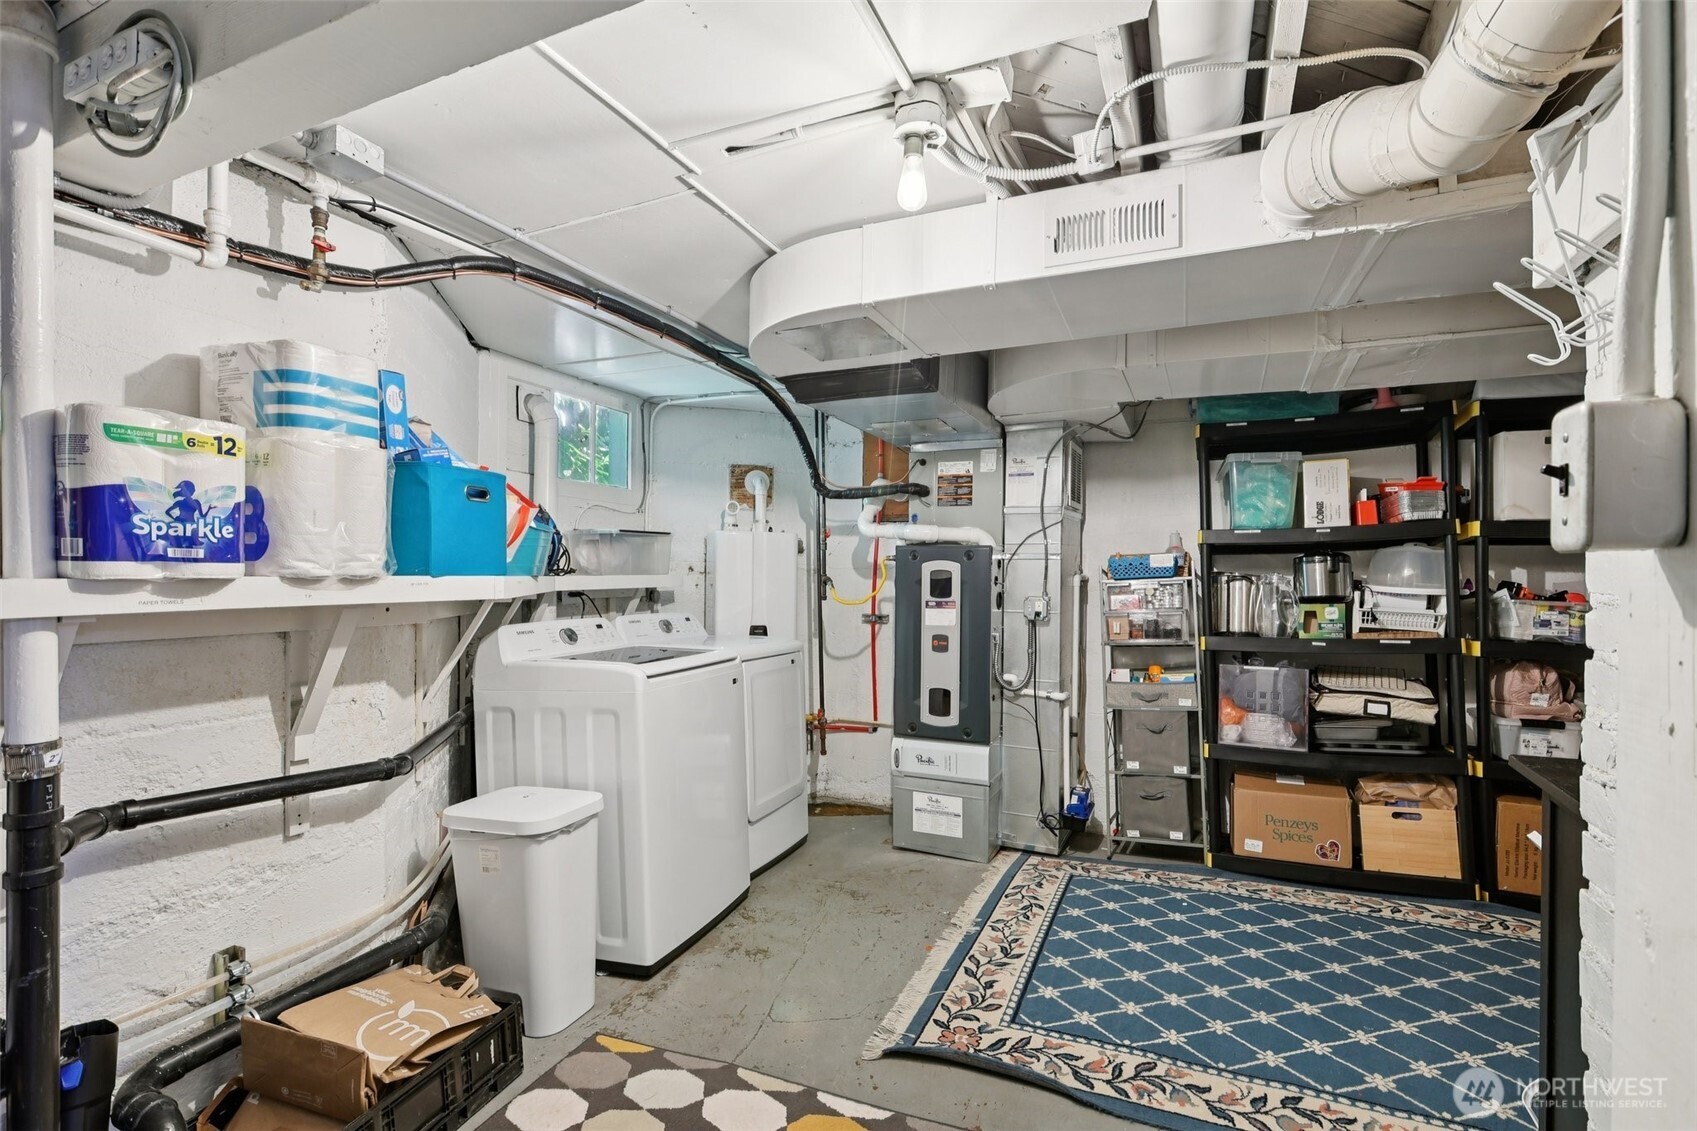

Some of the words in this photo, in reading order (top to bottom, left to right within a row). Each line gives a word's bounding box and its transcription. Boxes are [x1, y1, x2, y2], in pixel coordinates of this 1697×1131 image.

[110, 427, 154, 438] TEAR-A-SQUARE
[186, 437, 196, 448] 6
[213, 436, 237, 457] 12
[1315, 501, 1325, 525] LODGE
[131, 514, 234, 544] Sparkle
[1265, 814, 1319, 833] Penzeys
[1272, 828, 1314, 844] Spices
